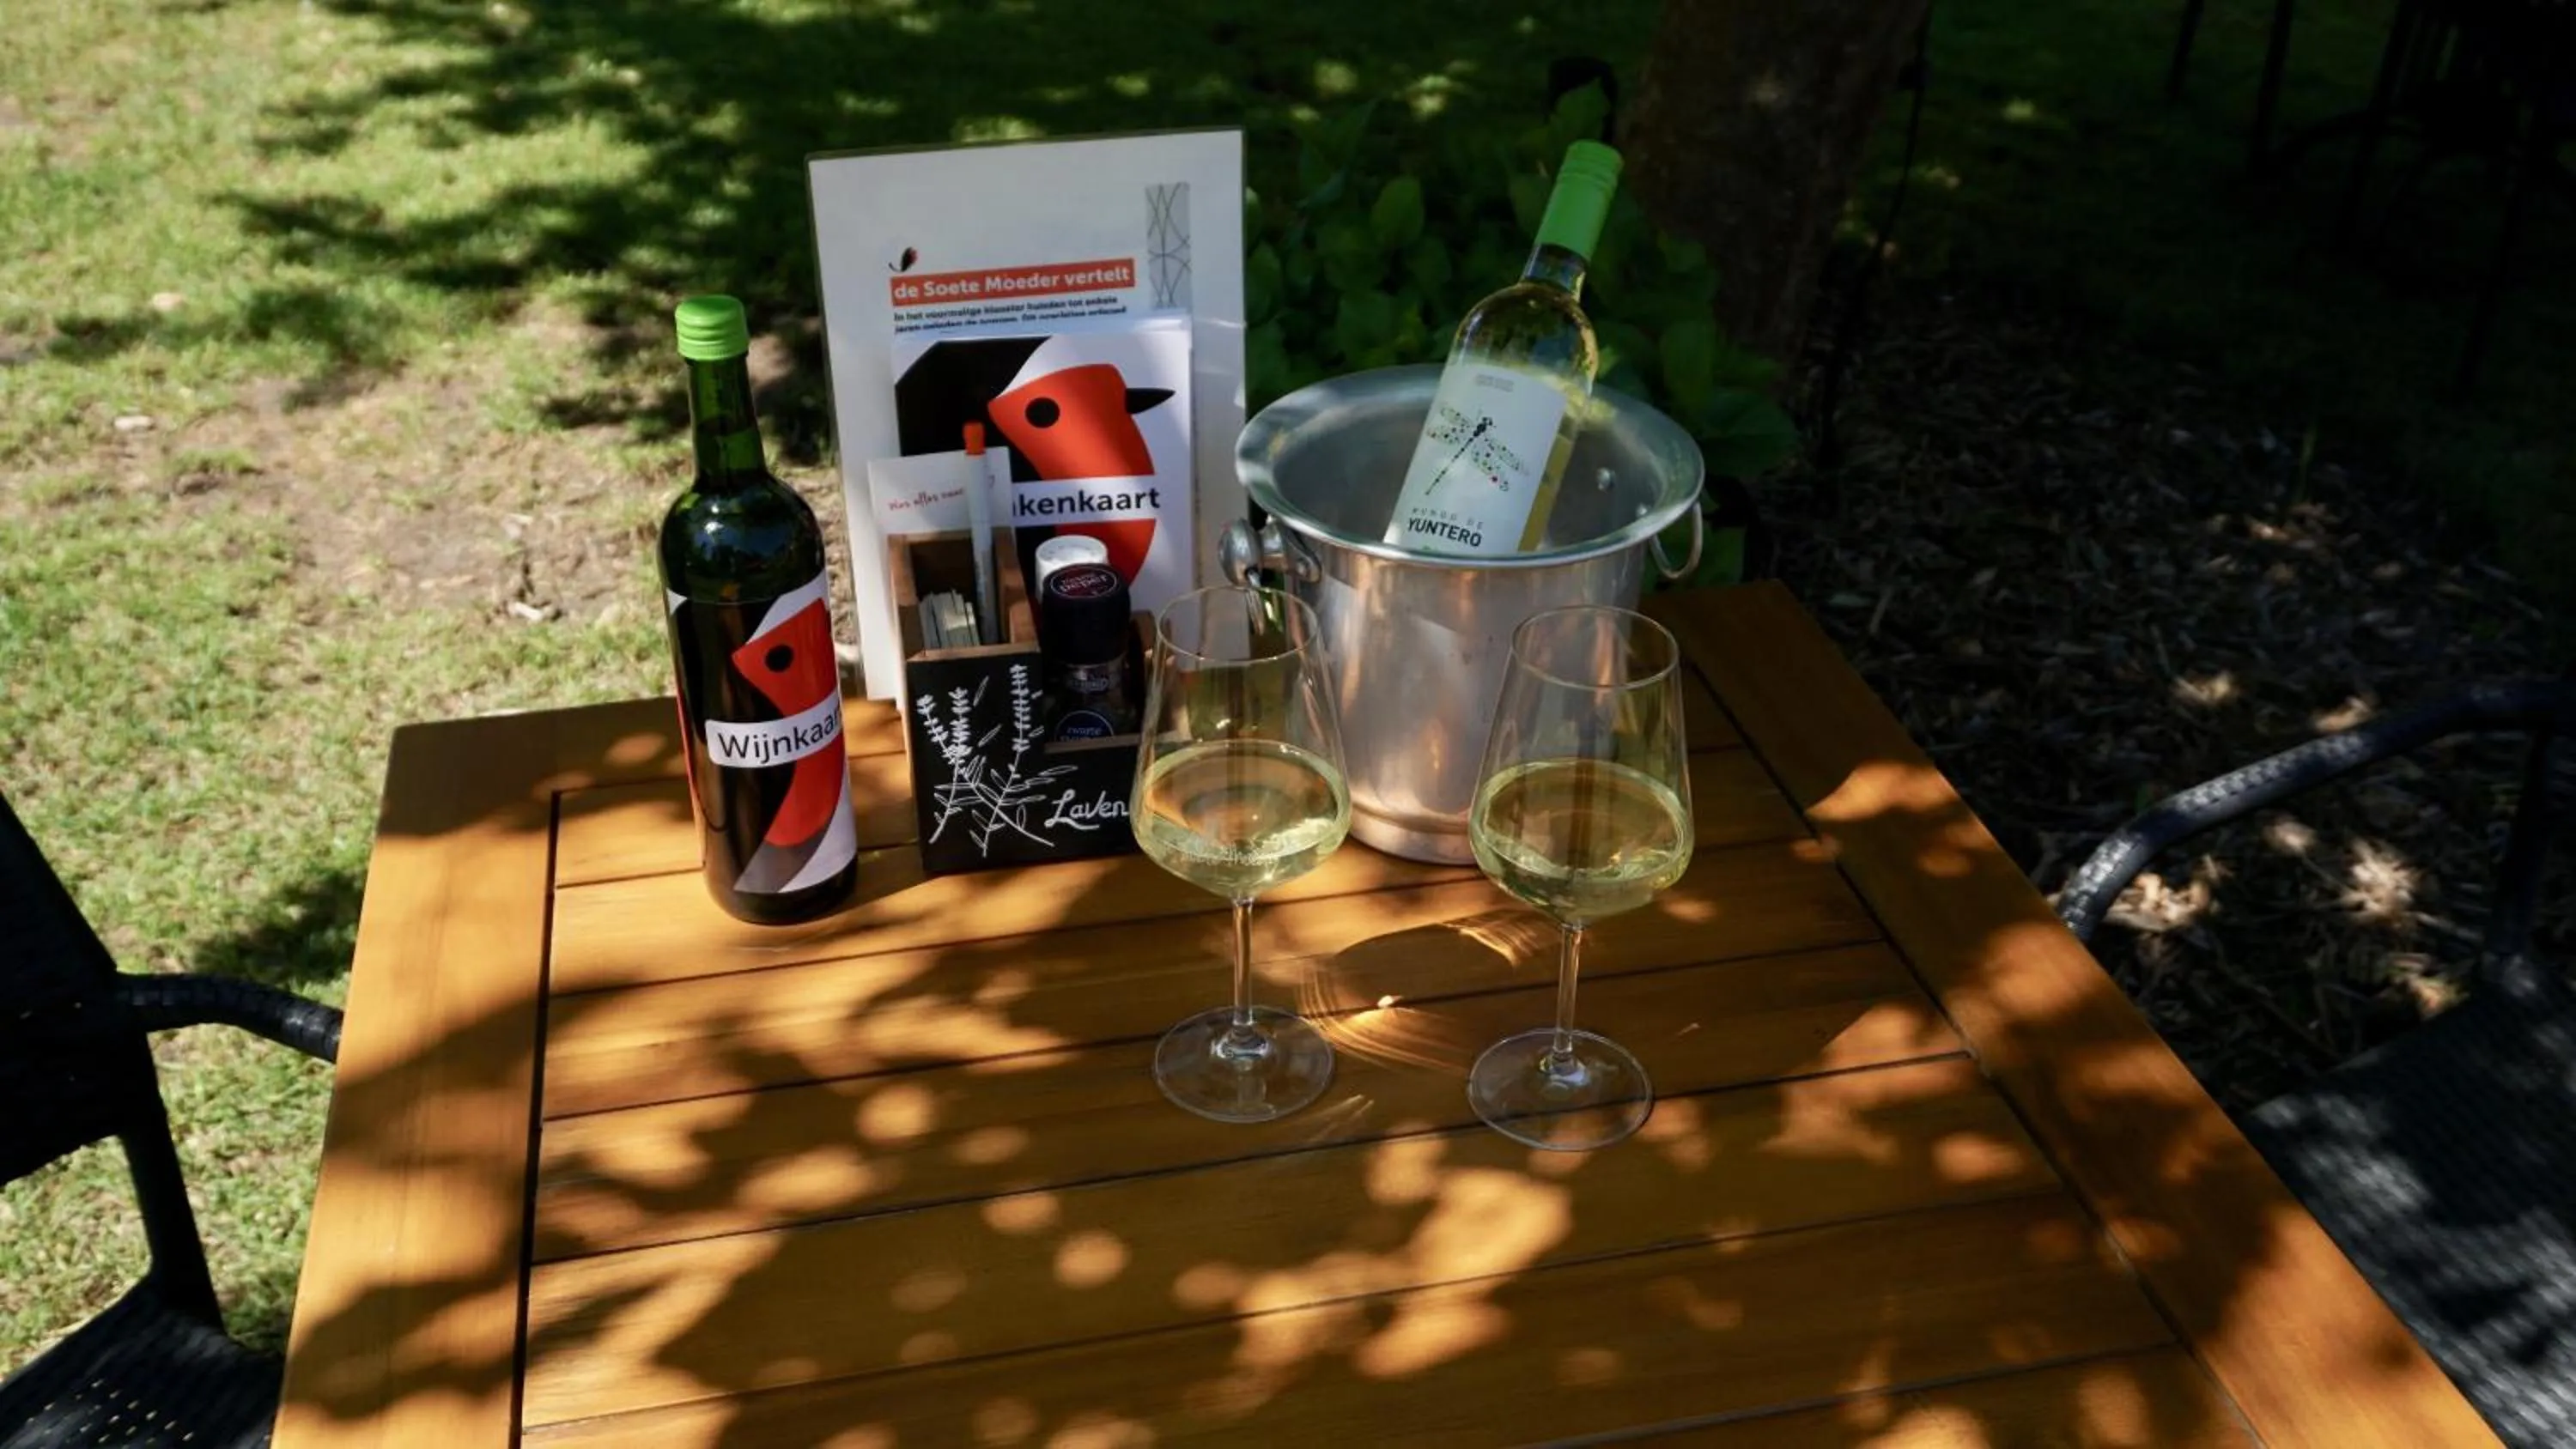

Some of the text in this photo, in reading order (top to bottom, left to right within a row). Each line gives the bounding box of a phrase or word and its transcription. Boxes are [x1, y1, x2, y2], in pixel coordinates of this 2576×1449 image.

[894, 266, 1130, 300] de Soete Moeder vertelt
[1408, 517, 1482, 548] YUNTERO
[718, 702, 841, 765] Wijnkaar
[1044, 789, 1130, 830] Laven
